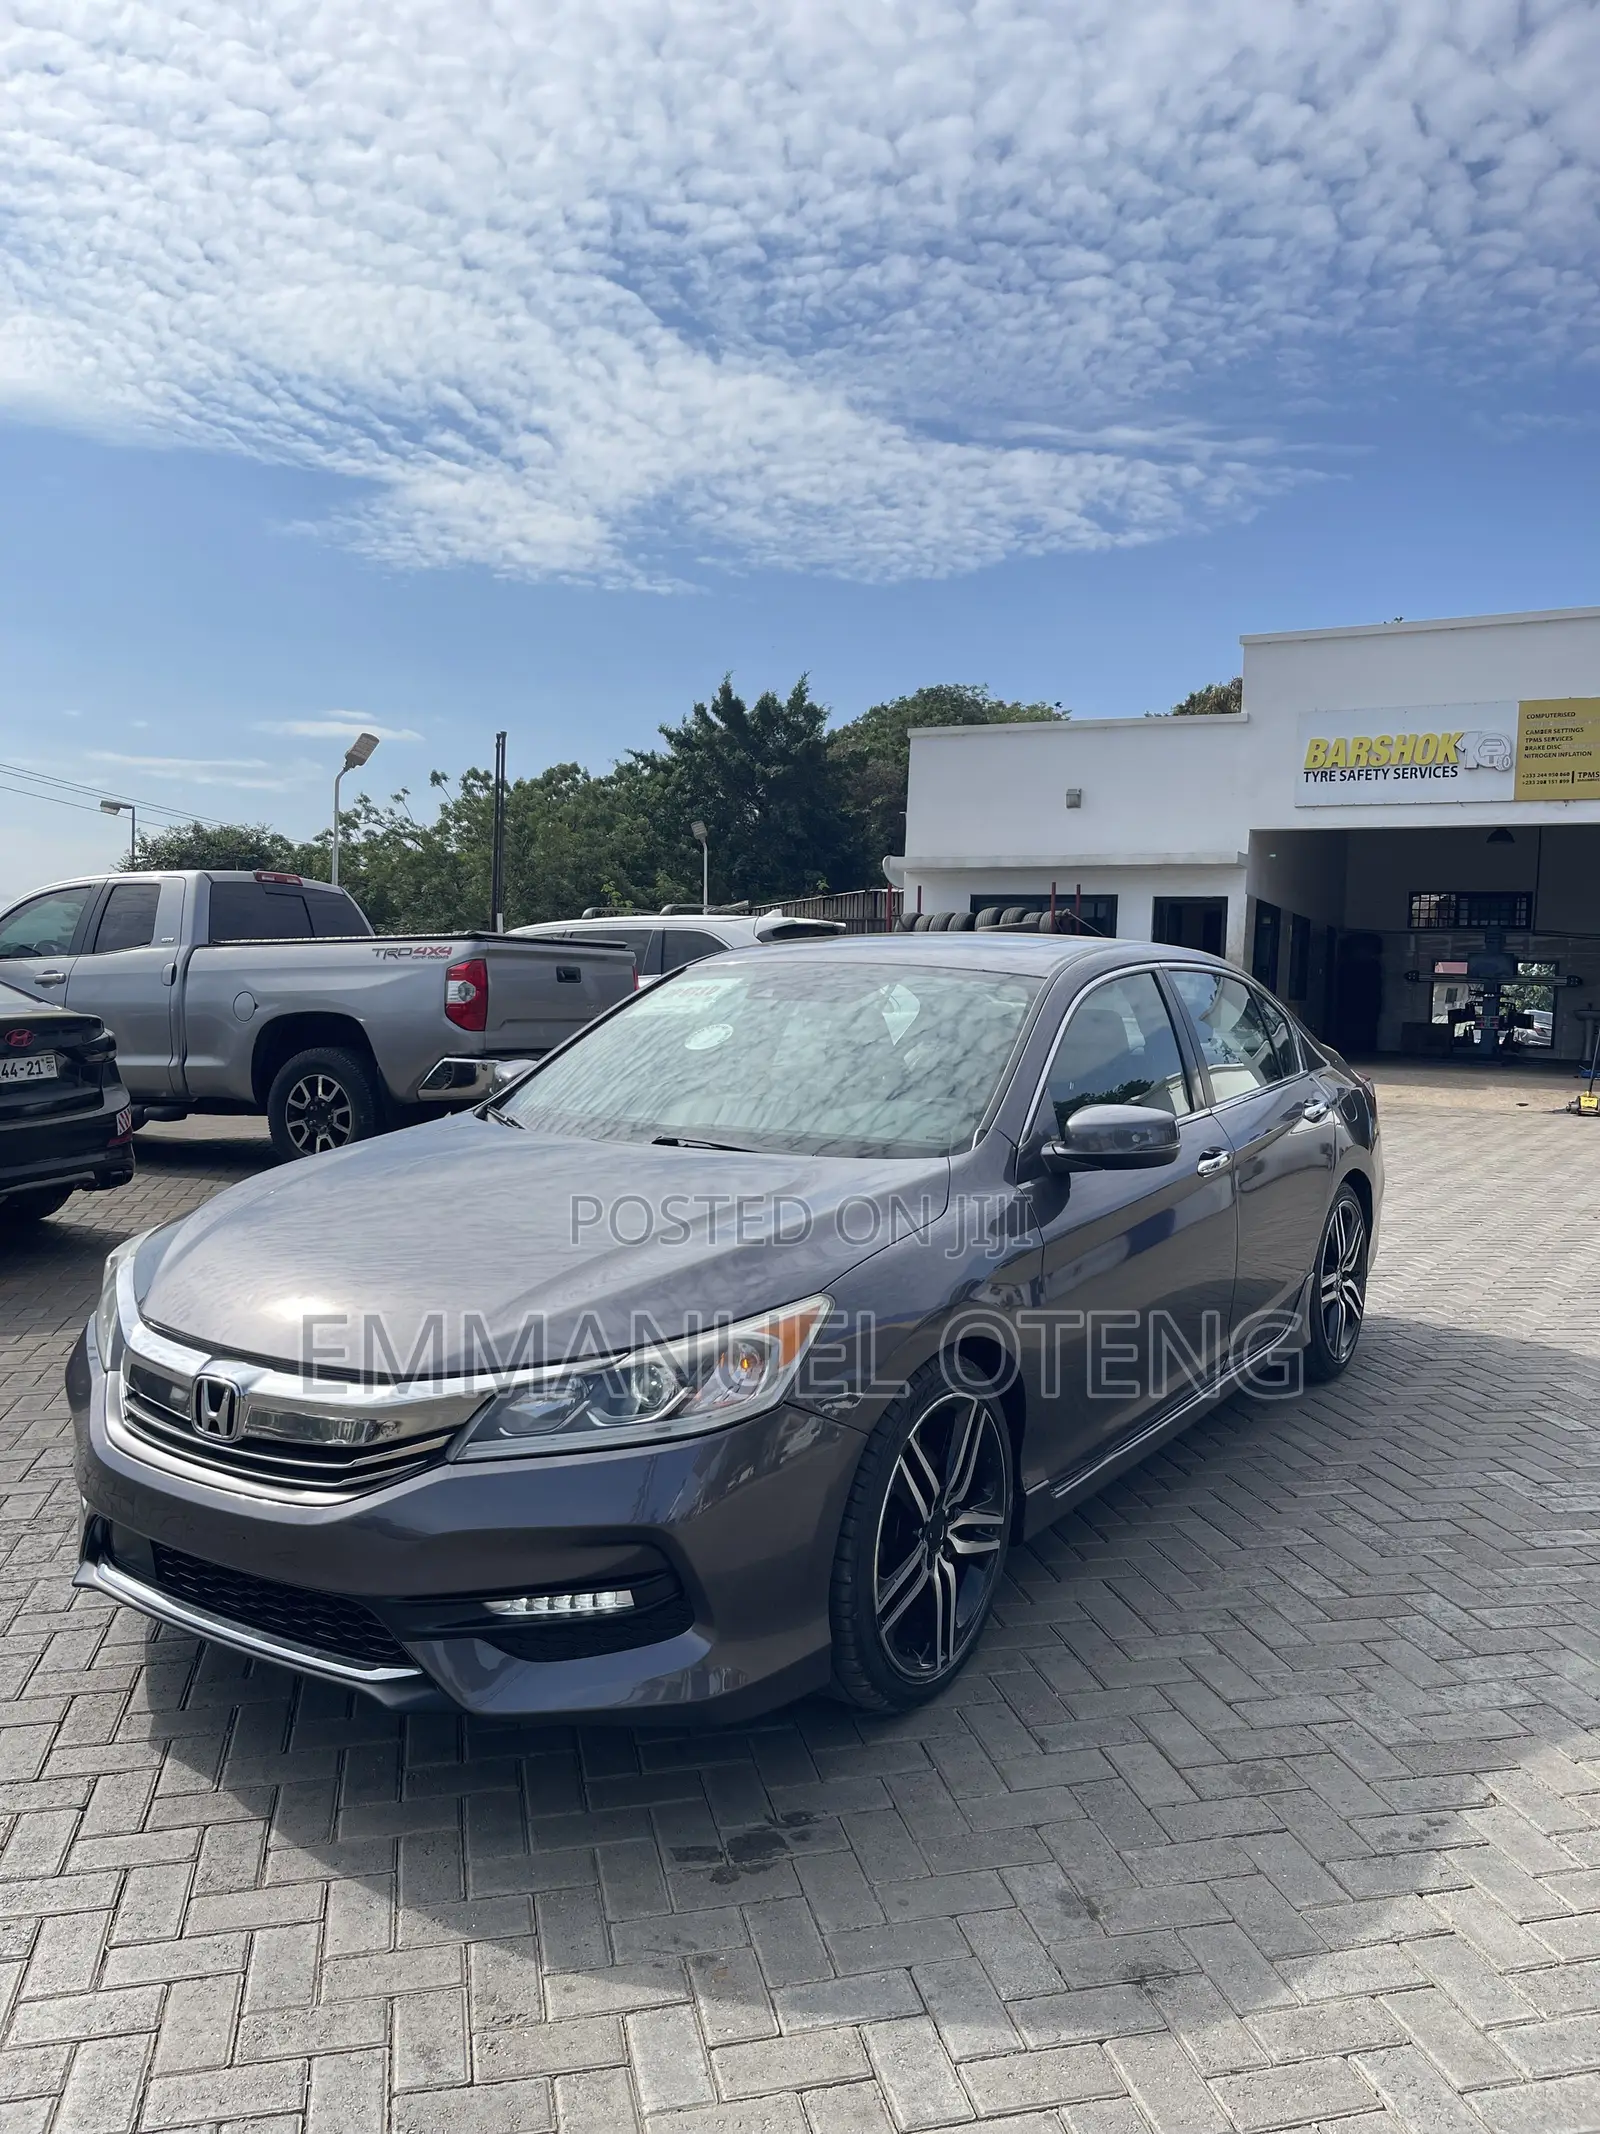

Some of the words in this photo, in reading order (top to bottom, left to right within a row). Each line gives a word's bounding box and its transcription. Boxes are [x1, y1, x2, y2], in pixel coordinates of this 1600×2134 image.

[1526, 711, 1576, 719] COMPUTERISED
[1304, 732, 1465, 770] BARSHOK
[1304, 770, 1336, 783] TYRE
[1339, 767, 1392, 782] SAFETY
[1393, 765, 1458, 780] SERVICES
[372, 947, 412, 960] TRD
[0, 1059, 44, 1079] 44-21
